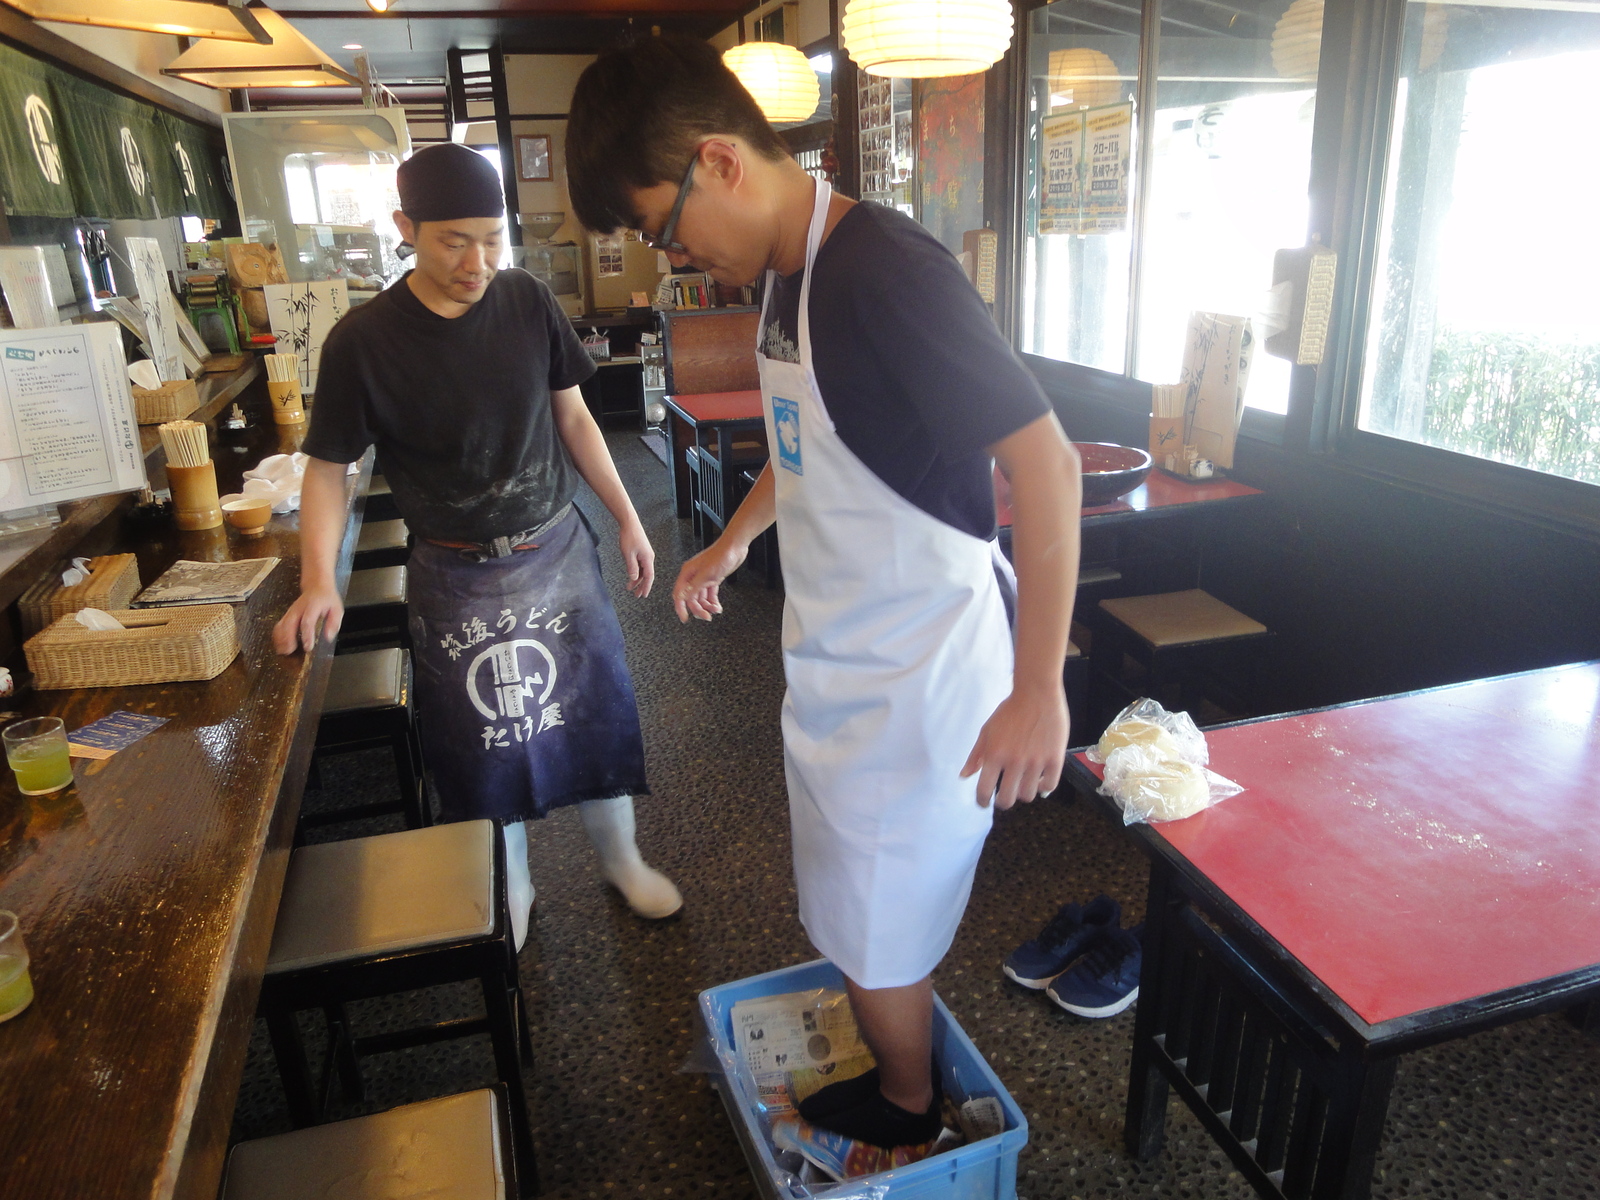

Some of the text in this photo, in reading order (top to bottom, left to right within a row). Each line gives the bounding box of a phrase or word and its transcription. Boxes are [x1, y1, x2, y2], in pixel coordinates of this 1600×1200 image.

[1049, 147, 1073, 160] グローバル
[1093, 141, 1119, 155] グローバル
[441, 607, 571, 661] 筑後うどん
[481, 702, 566, 751] たけ屋
